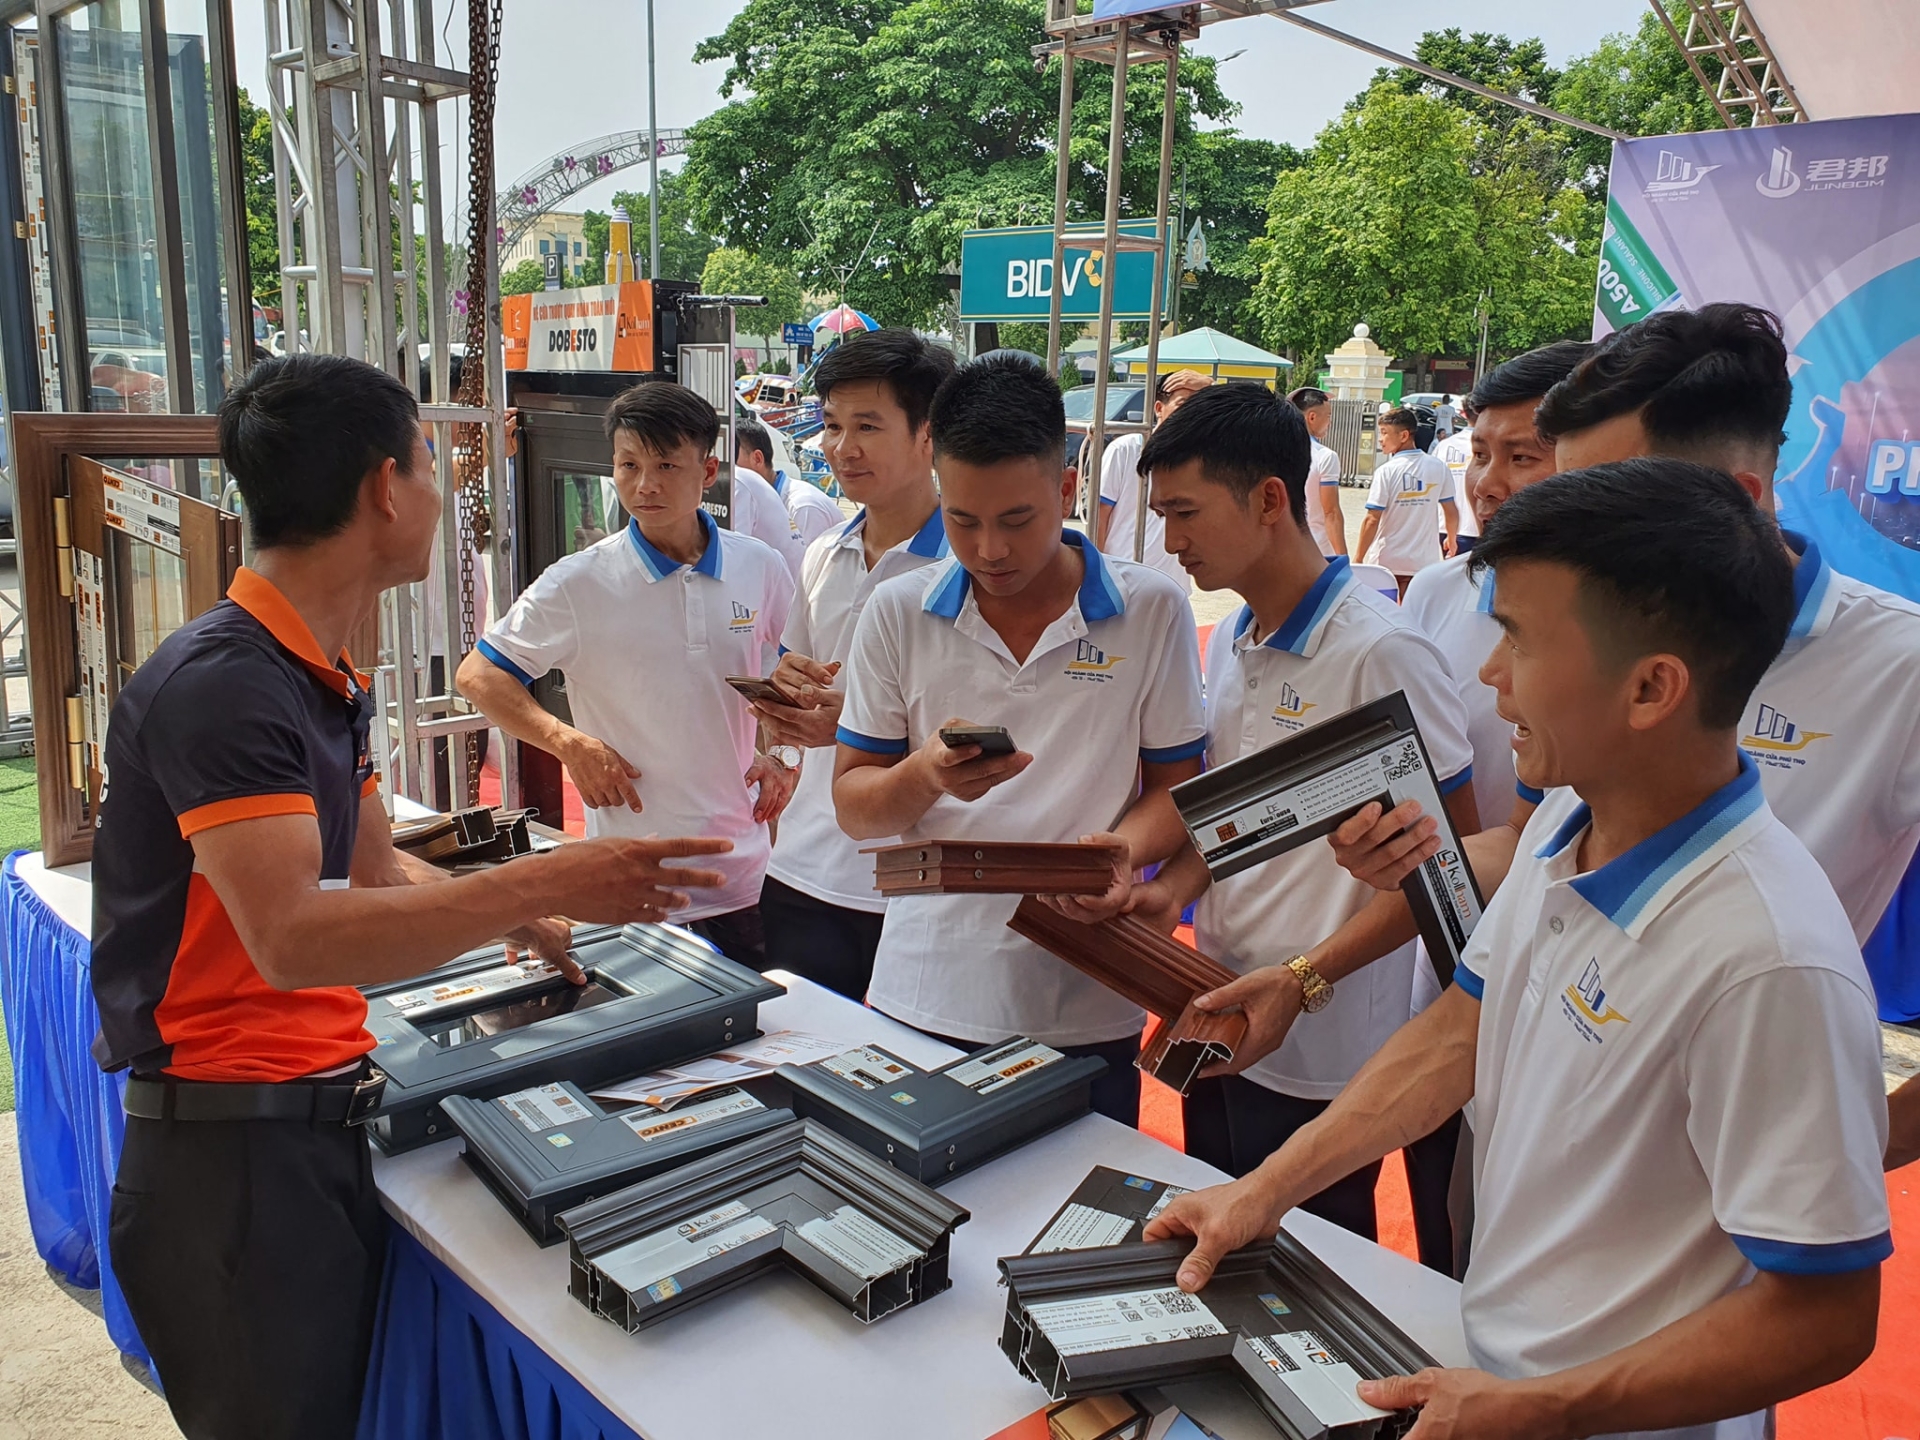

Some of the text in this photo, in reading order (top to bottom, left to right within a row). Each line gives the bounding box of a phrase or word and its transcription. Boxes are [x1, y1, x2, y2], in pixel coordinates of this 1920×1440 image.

[1805, 155, 1889, 181] 君邦
[1804, 180, 1885, 191] JUNBOM
[548, 257, 555, 275] P
[1613, 235, 1663, 302] SILICONE SEALANT
[1007, 257, 1085, 298] BIDV
[549, 328, 597, 352] DOBESTO
[701, 501, 728, 518] OBESTO
[1446, 865, 1473, 920] Kollham
[1002, 1059, 1035, 1077] CENTO
[639, 1117, 688, 1138] CENTO
